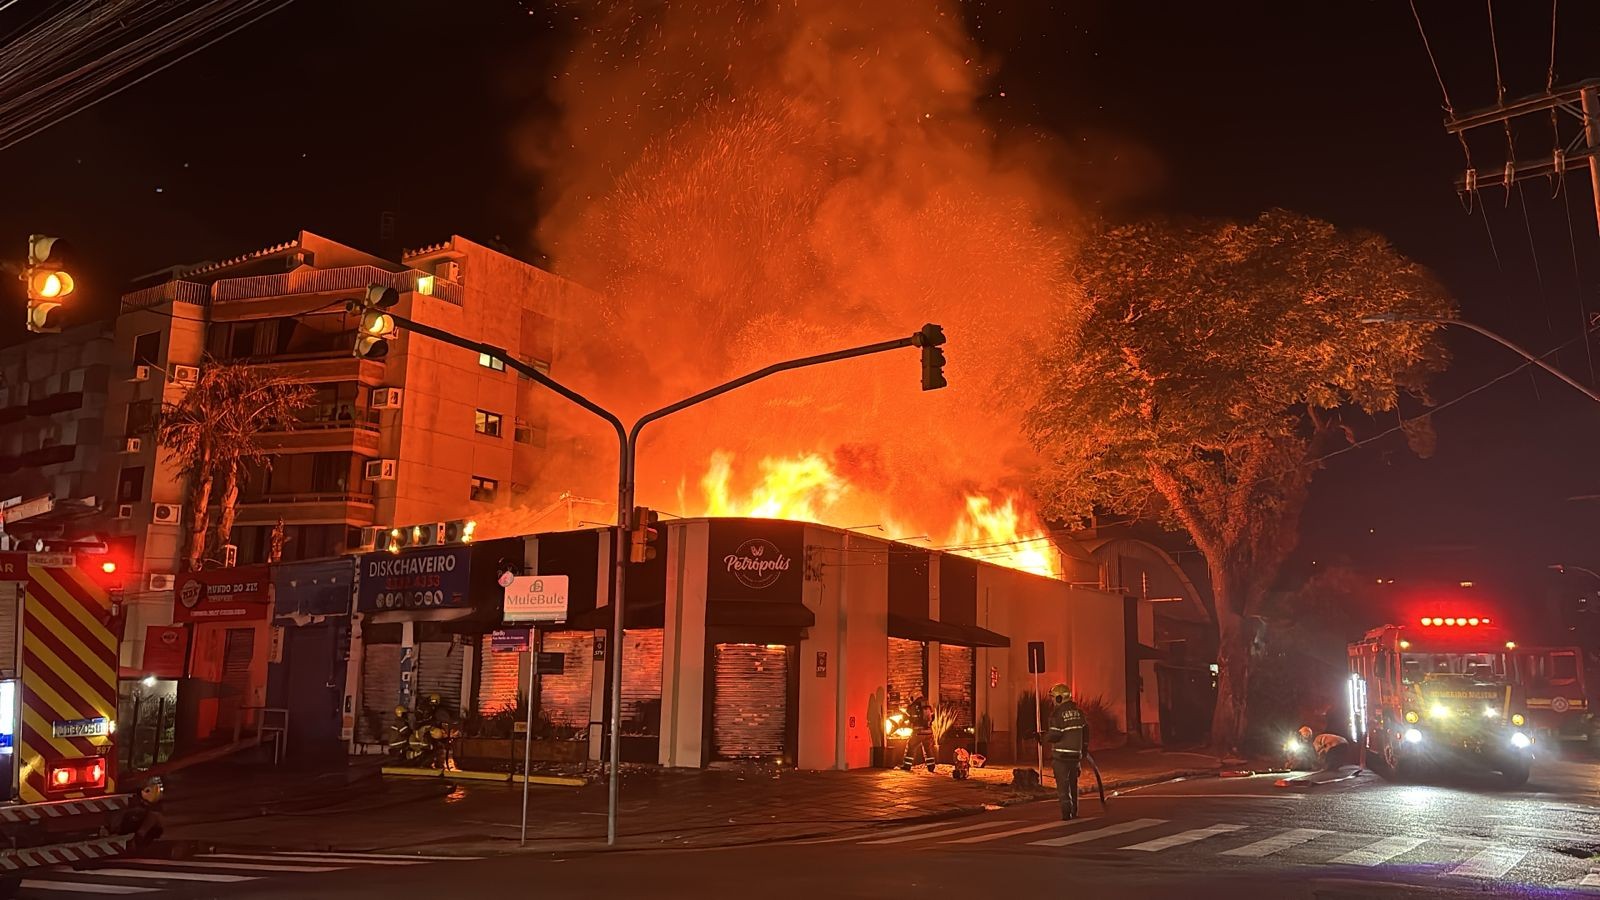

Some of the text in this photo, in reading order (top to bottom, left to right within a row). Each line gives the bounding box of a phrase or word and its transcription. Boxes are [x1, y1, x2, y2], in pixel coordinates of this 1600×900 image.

[369, 554, 456, 577] DISKCHAVEIRO
[724, 554, 791, 577] Petrópolis
[207, 584, 231, 594] MUNDO
[233, 583, 244, 593] DO
[507, 593, 564, 605] MuleBule
